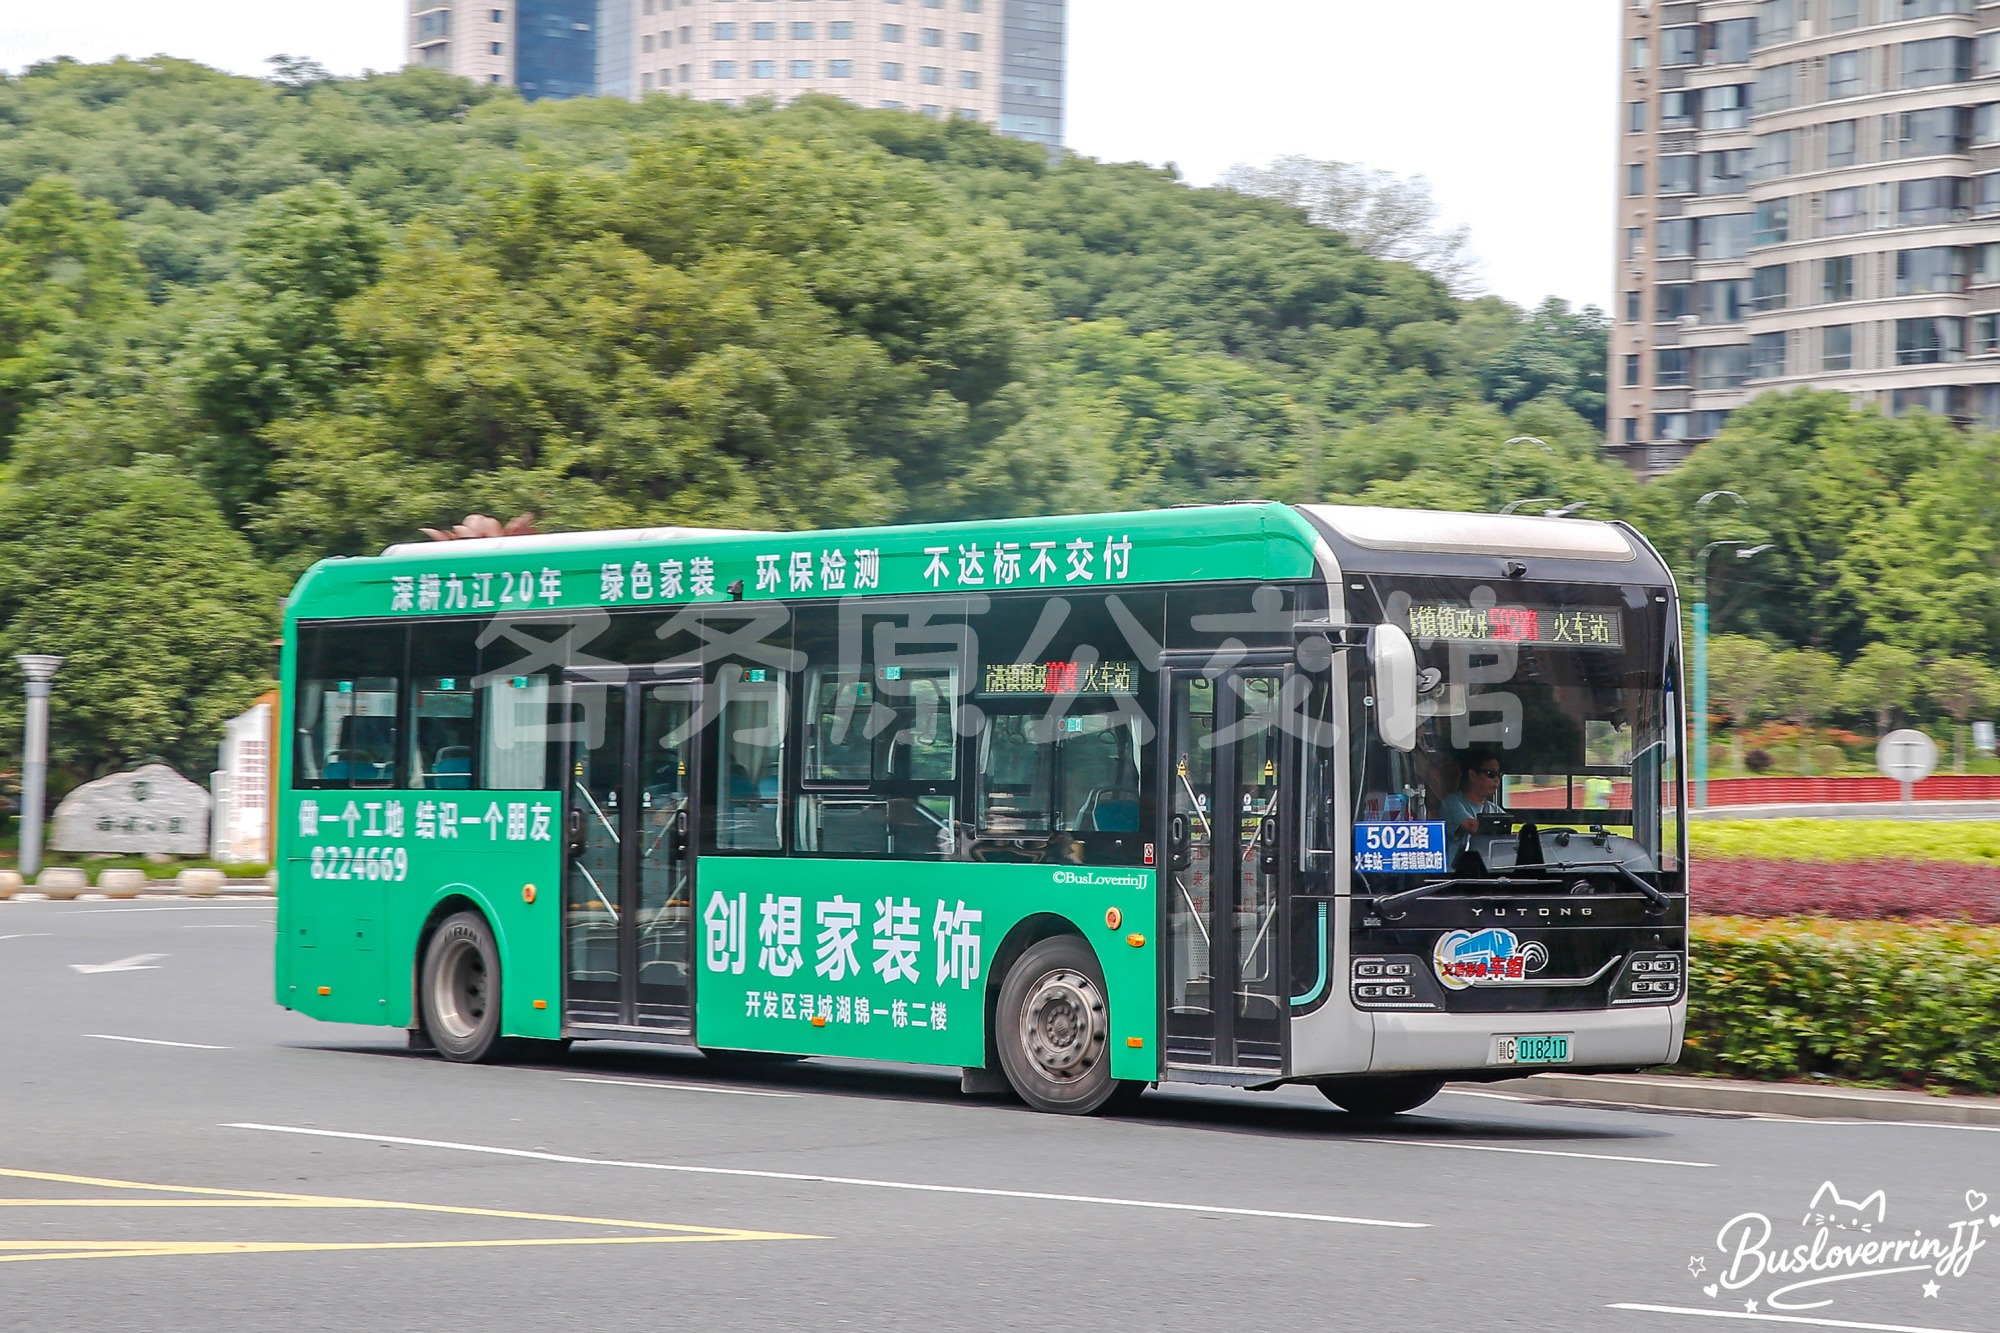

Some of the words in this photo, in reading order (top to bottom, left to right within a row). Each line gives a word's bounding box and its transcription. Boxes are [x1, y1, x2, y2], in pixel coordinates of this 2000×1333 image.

[391, 567, 562, 611] 深耕九江20年
[600, 556, 715, 602] 绿色家装
[755, 547, 880, 593] 环保检测
[923, 534, 1133, 588] 不达标不交付
[1552, 611, 1609, 644] 火车站
[1083, 661, 1131, 693] 火车站
[298, 800, 405, 838] 做一个工地
[414, 801, 552, 841] 结识一个朋友
[1366, 825, 1430, 849] 502路
[310, 846, 408, 881] 8224669
[1472, 908, 1593, 916] YUTONG
[703, 890, 984, 990] 创想家装饰
[745, 990, 948, 1031] 开发区浔城湖锦一栋二楼
